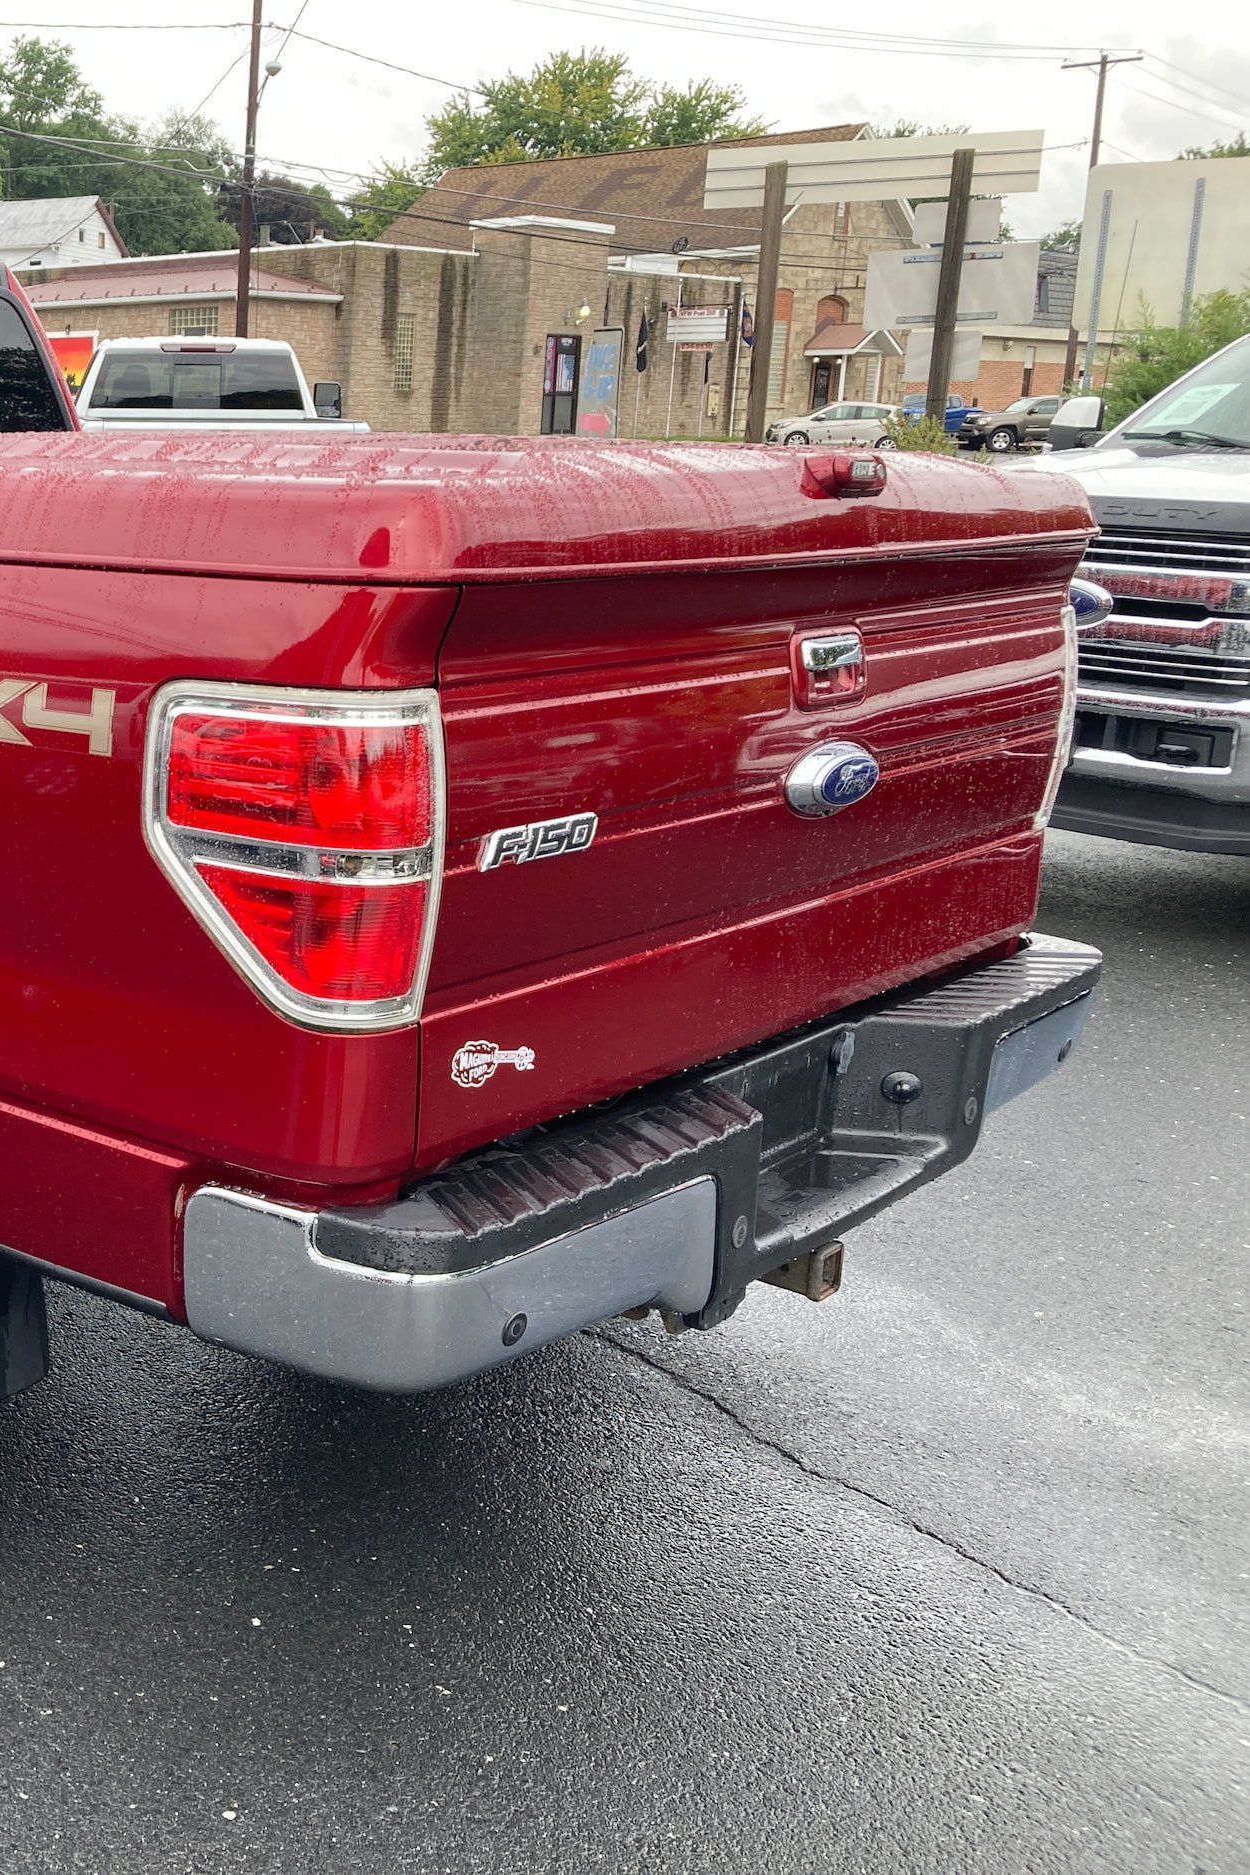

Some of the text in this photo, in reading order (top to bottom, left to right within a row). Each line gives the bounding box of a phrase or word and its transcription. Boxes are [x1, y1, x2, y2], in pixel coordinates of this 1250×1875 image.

[1101, 504, 1219, 521] DUTY
[834, 761, 879, 798] Ford
[486, 813, 598, 870] F-150
[469, 1064, 488, 1082] FORD
